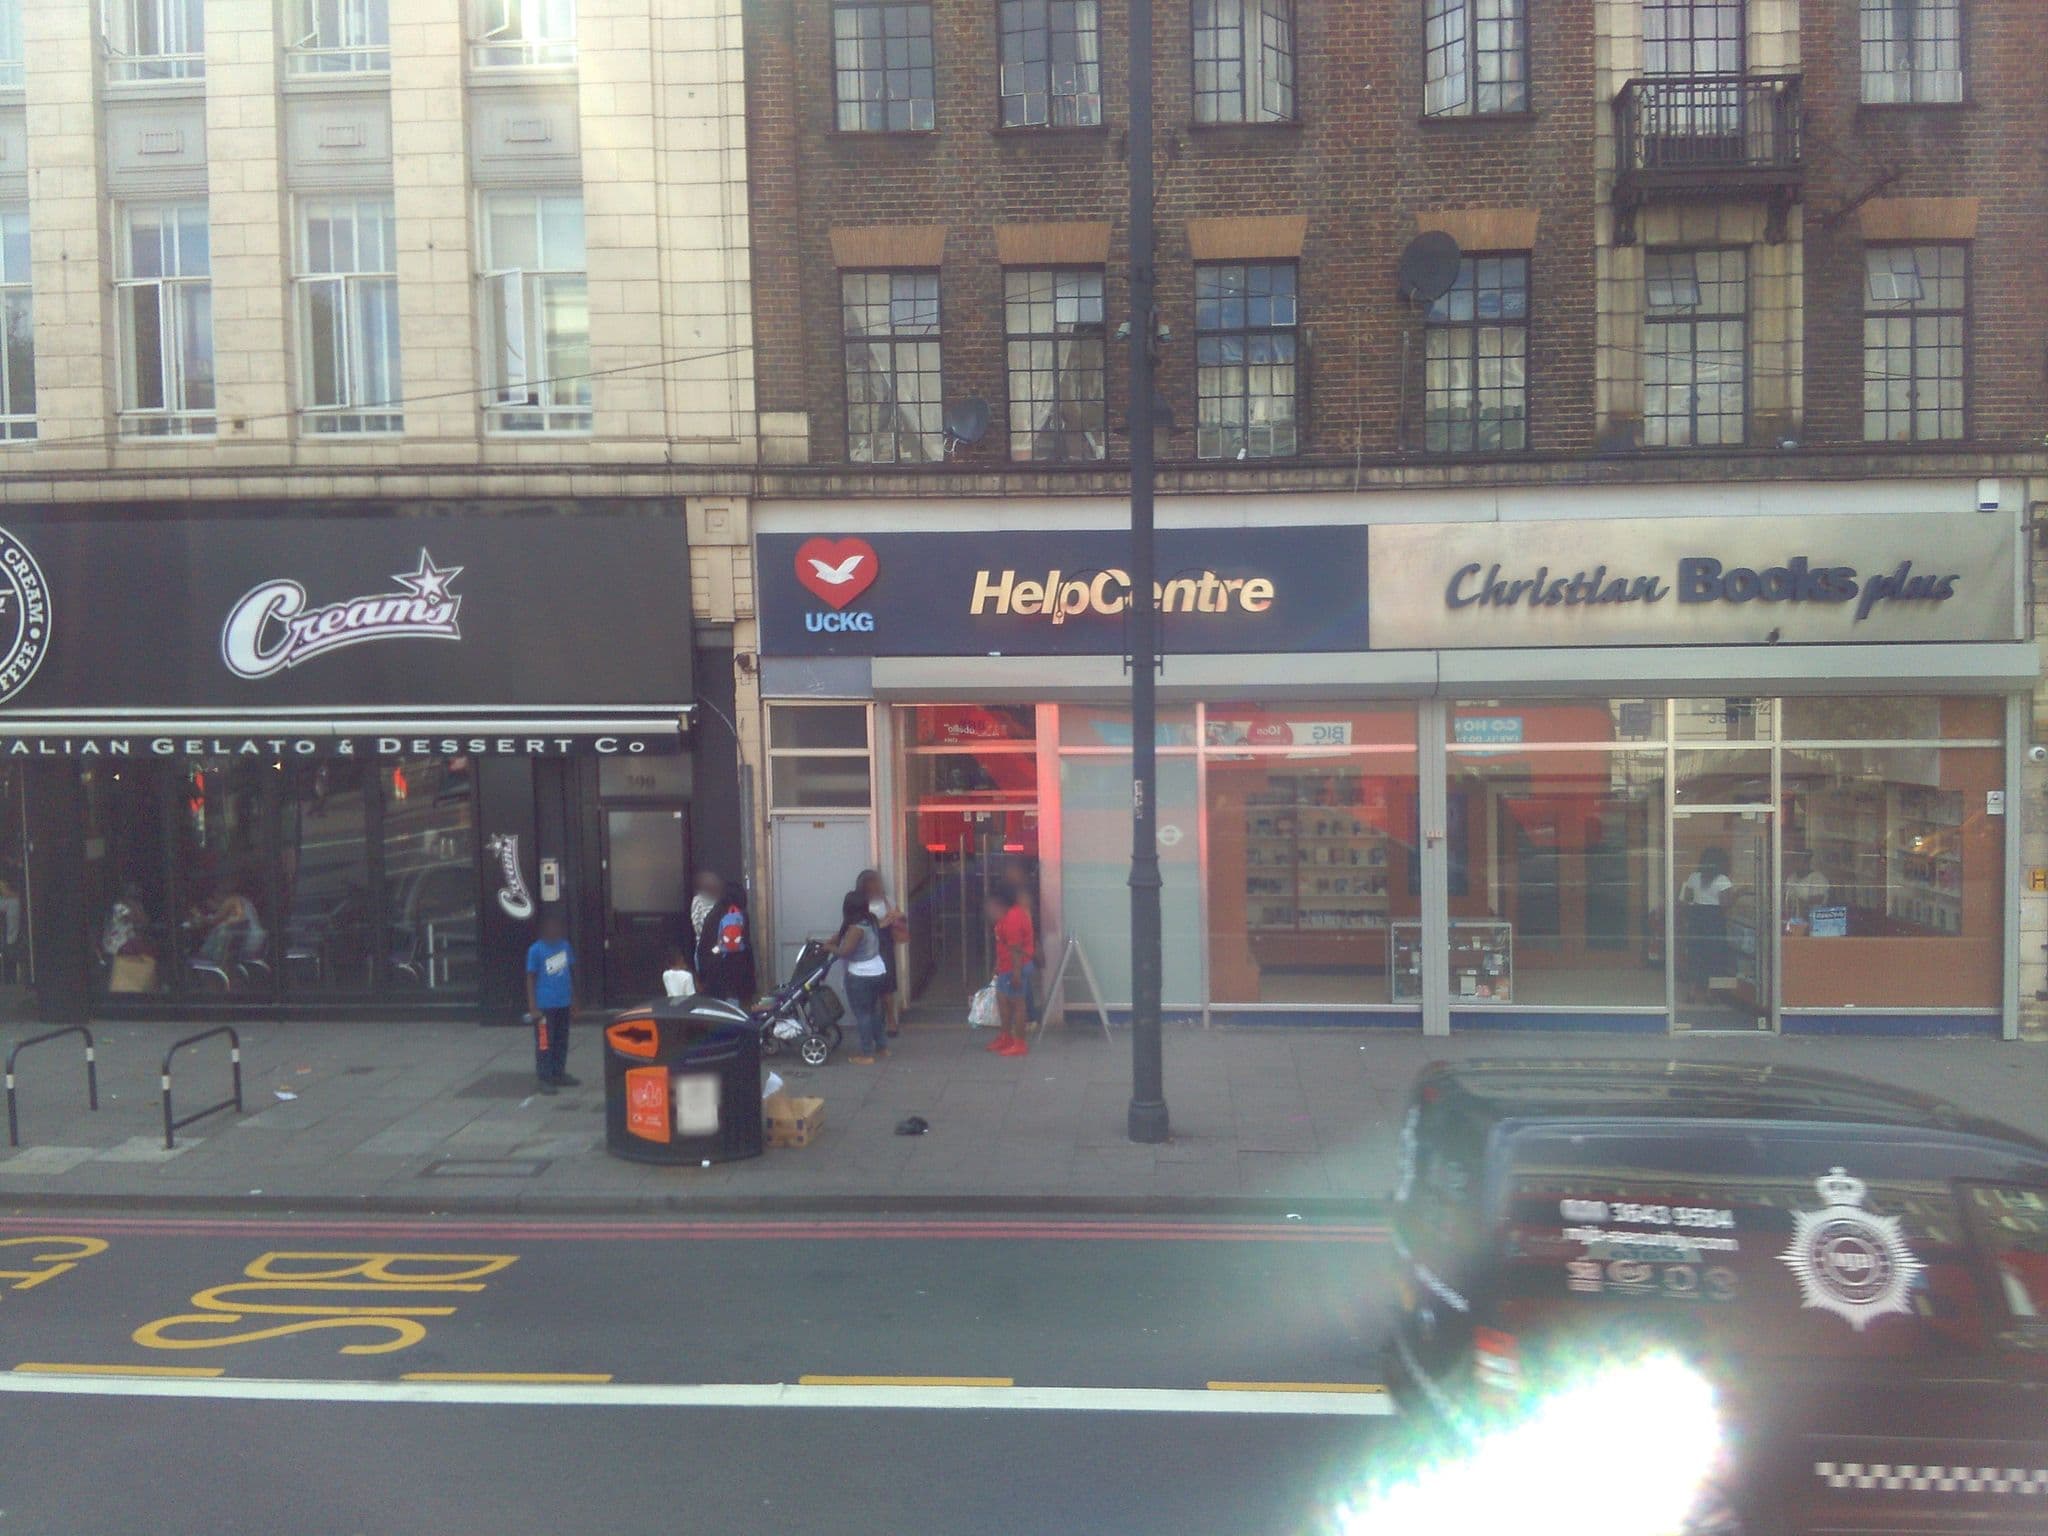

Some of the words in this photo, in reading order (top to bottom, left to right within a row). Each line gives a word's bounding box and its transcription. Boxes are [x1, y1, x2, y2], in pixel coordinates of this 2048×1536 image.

[4, 548, 43, 624] CREAM
[1446, 562, 1669, 608] Christian
[1678, 556, 1858, 602] Books
[1853, 560, 1960, 621] plus
[805, 612, 874, 632] UCKG
[0, 740, 130, 755] ALIAN
[338, 740, 354, 754] &
[132, 1251, 520, 1355] BUS
